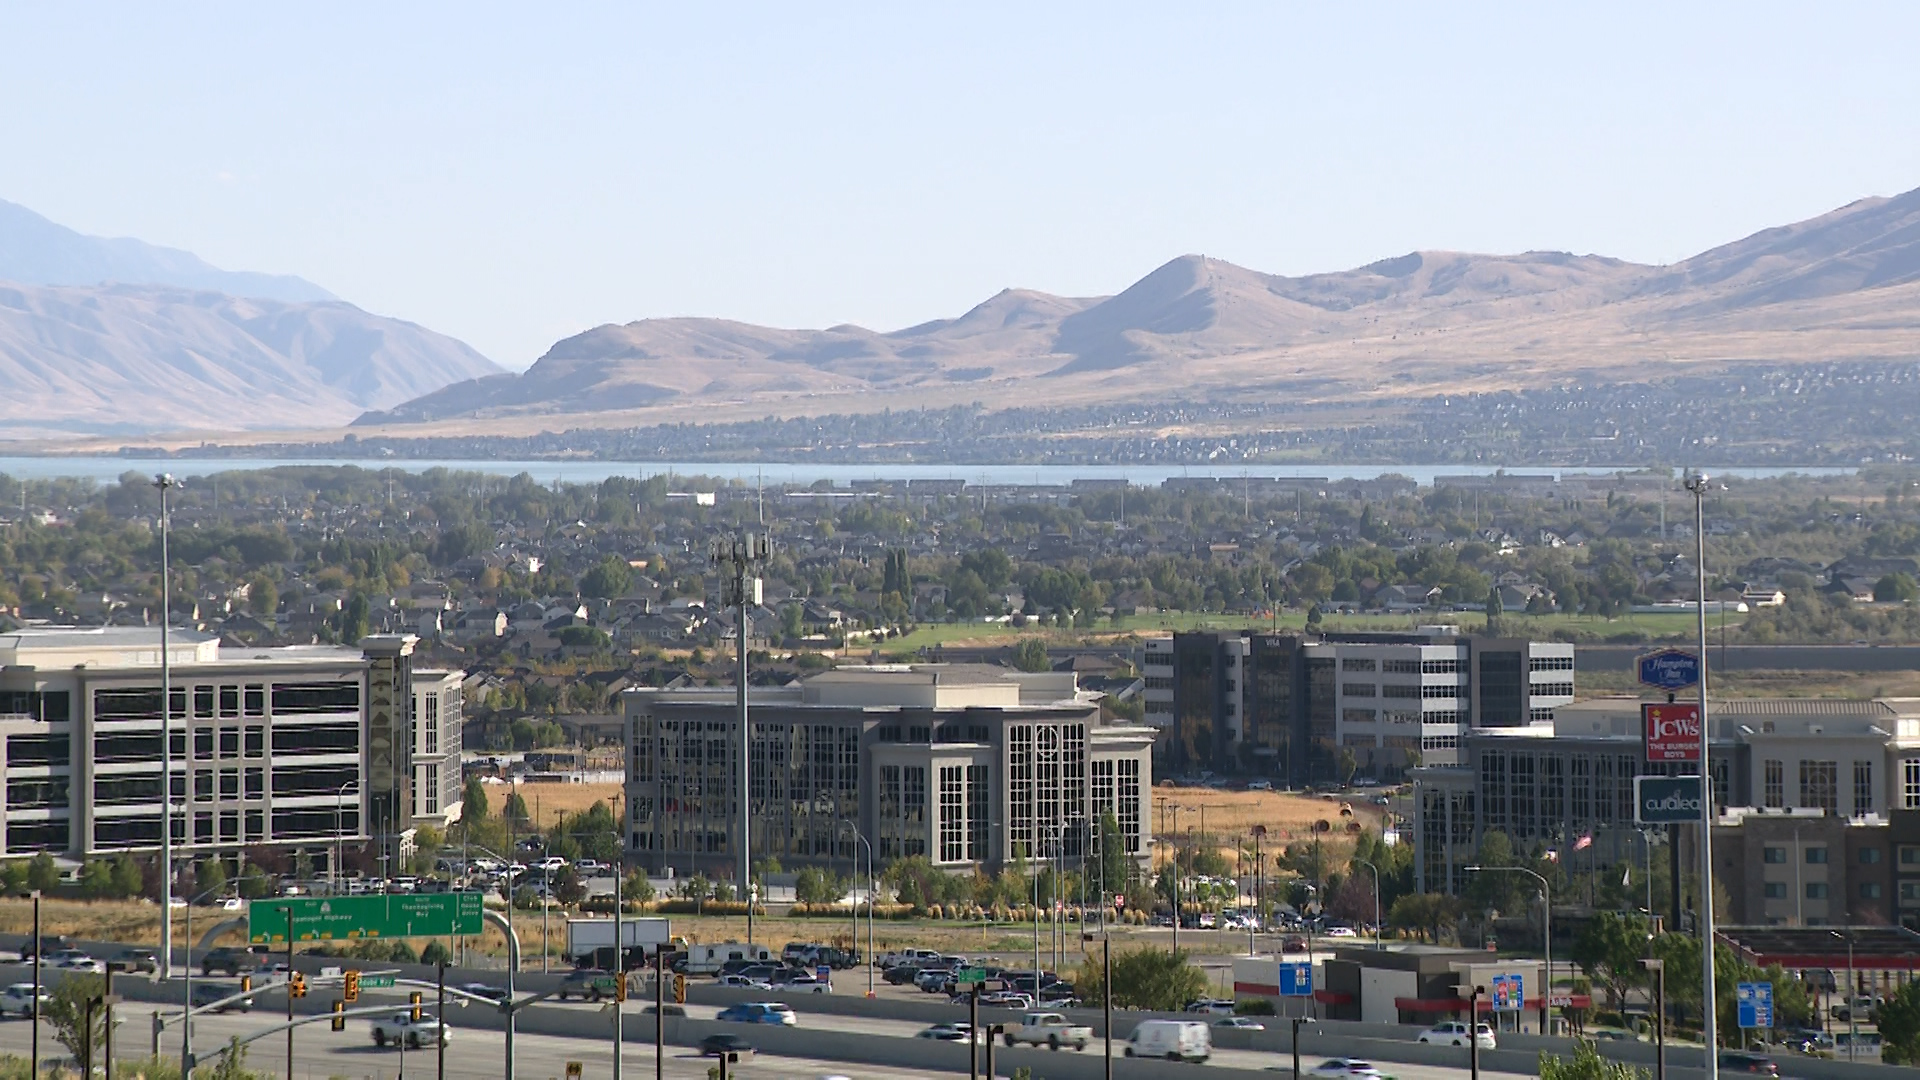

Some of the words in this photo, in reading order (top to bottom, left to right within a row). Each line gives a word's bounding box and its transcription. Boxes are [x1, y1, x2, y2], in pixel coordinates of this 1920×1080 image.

[1647, 658, 1695, 670] Hampton
[1660, 669, 1686, 680] Inn
[1646, 791, 1701, 810] curalea
